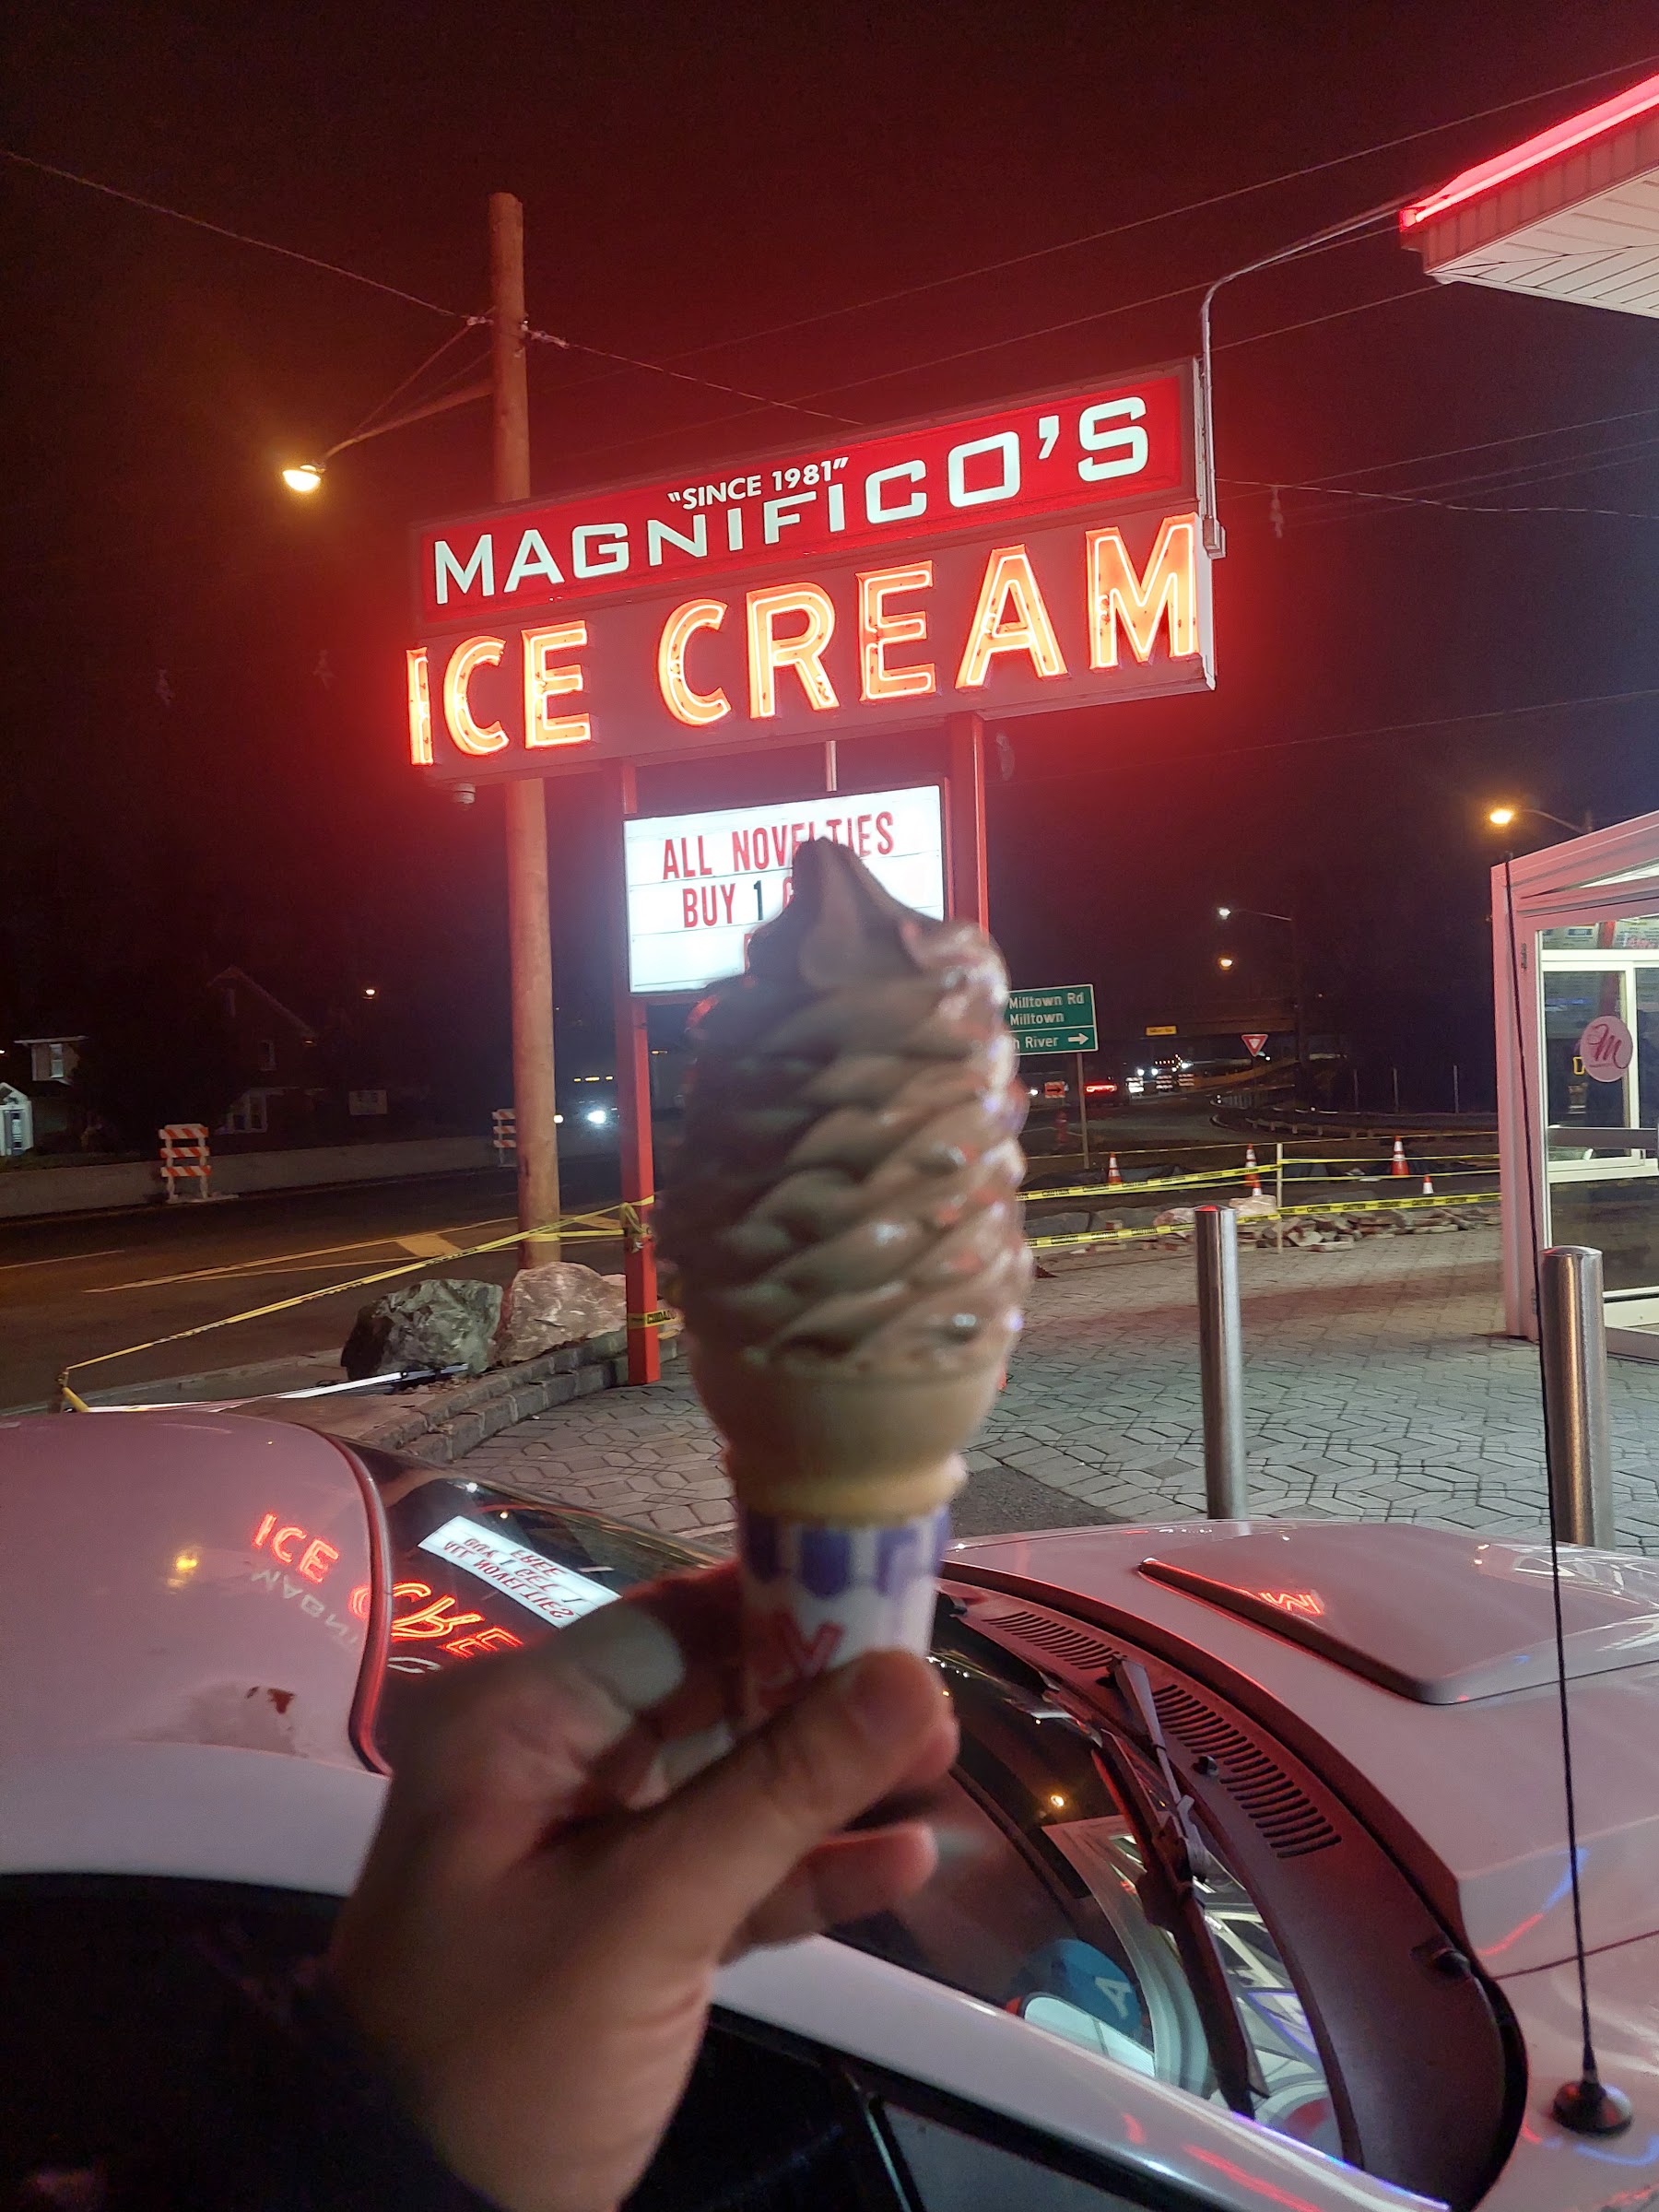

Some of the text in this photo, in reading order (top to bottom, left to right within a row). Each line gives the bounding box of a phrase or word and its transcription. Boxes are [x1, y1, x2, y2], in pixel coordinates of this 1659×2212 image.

[433, 395, 1150, 606] MAGNIFICO'S
[406, 512, 1202, 767] ICE CREAM
[663, 835, 712, 880] ALL
[682, 883, 735, 928] BUY
[753, 880, 764, 921] 1
[1008, 992, 1085, 1009] Milltown Rd
[1009, 1012, 1065, 1026] Milltown
[1025, 1036, 1059, 1048] River
